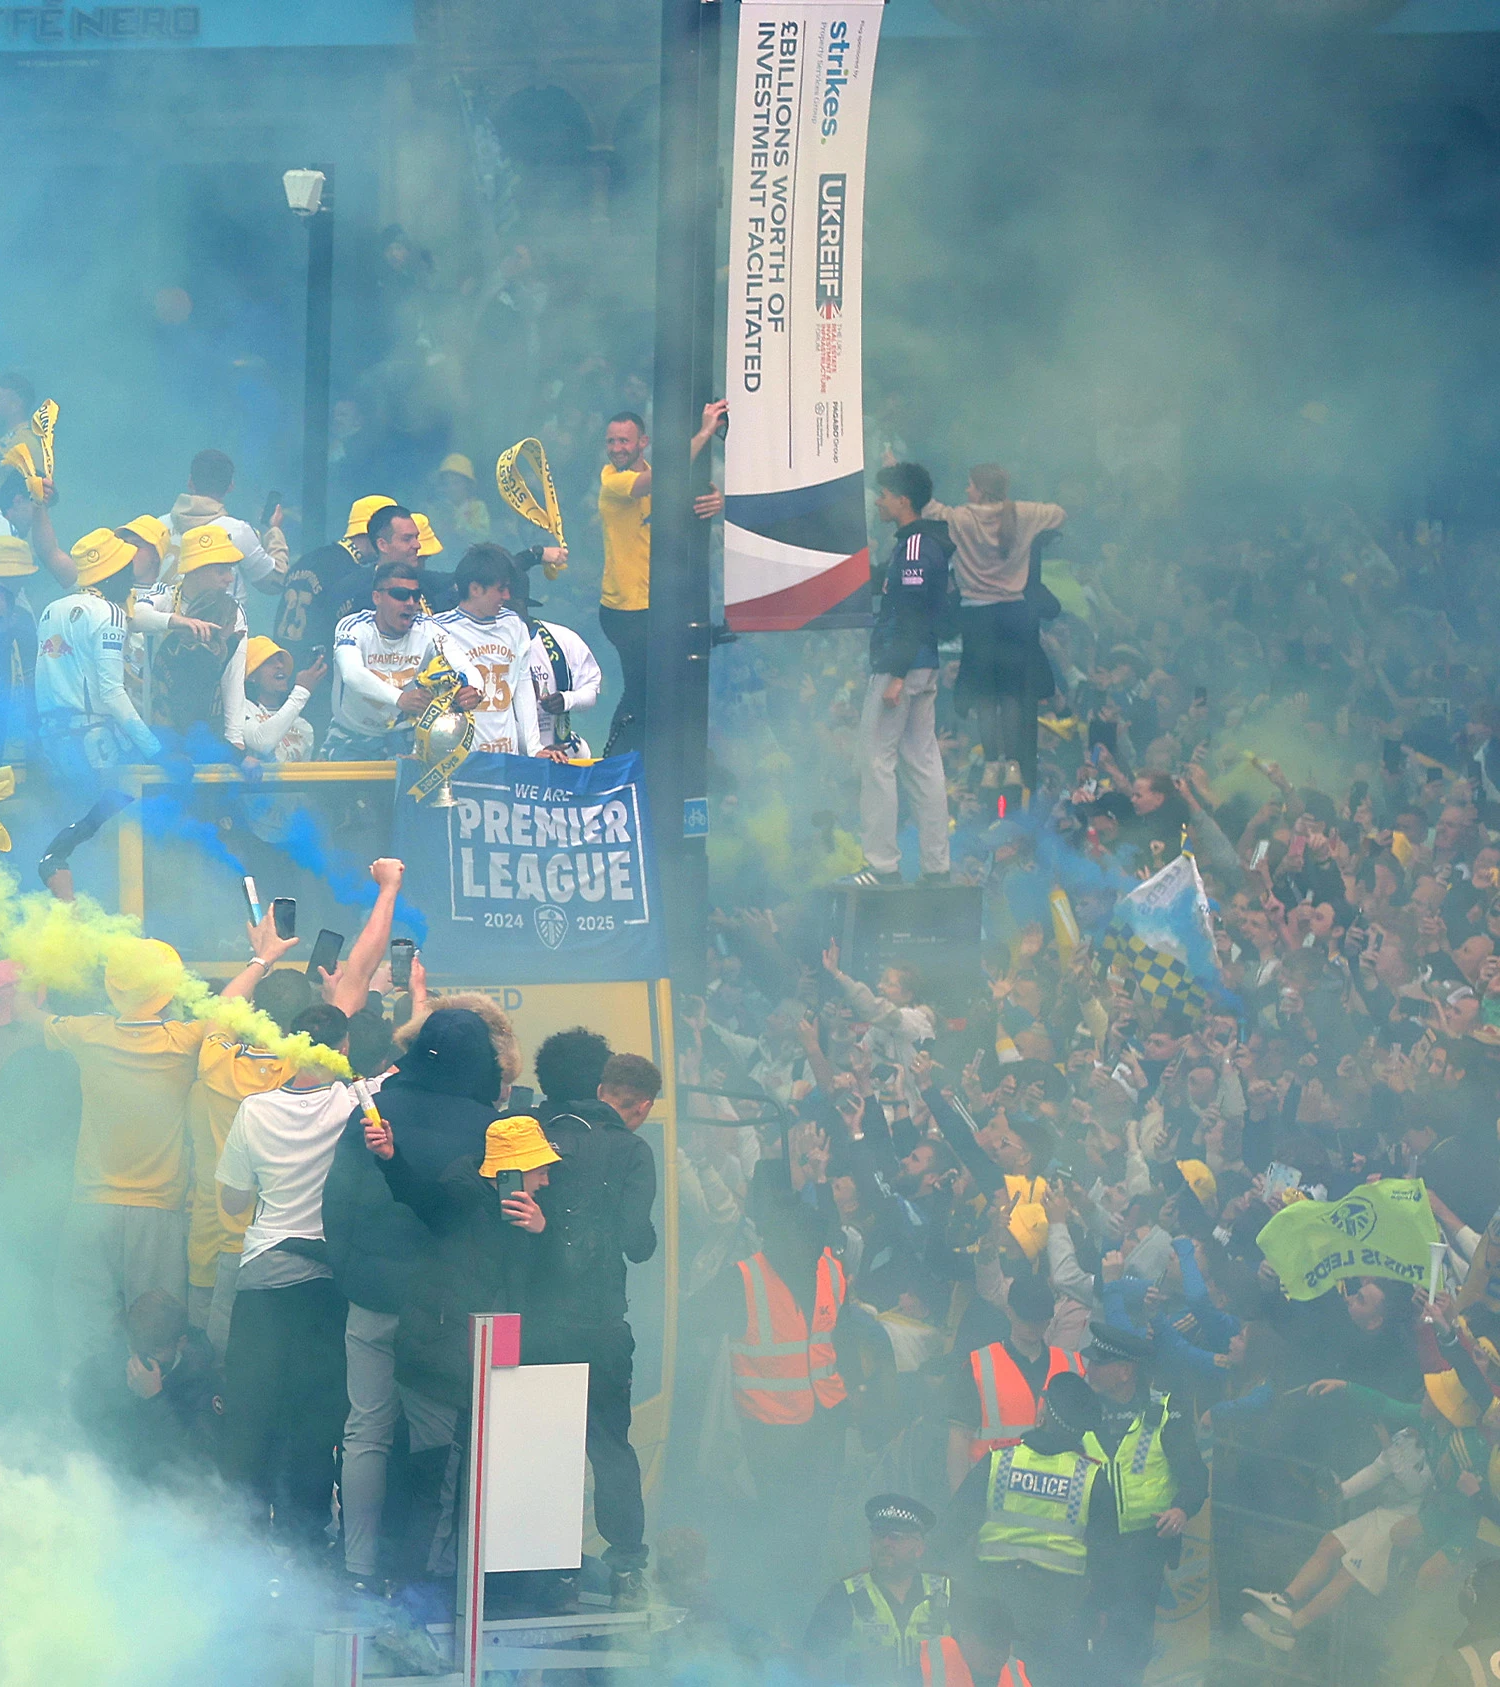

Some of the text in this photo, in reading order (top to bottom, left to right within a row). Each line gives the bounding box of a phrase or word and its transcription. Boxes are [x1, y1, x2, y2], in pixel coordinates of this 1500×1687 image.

[71, 5, 200, 41] NERO
[768, 20, 798, 333] £BILLIONS WORTH OF
[744, 22, 776, 393] INVESTMENT FACILITATED
[514, 783, 574, 802] WE ARE
[456, 796, 631, 848] PREMIER
[460, 847, 634, 903] LEAGUE
[483, 912, 615, 931] 2024 2025
[1010, 1471, 1069, 1497] POLICE
